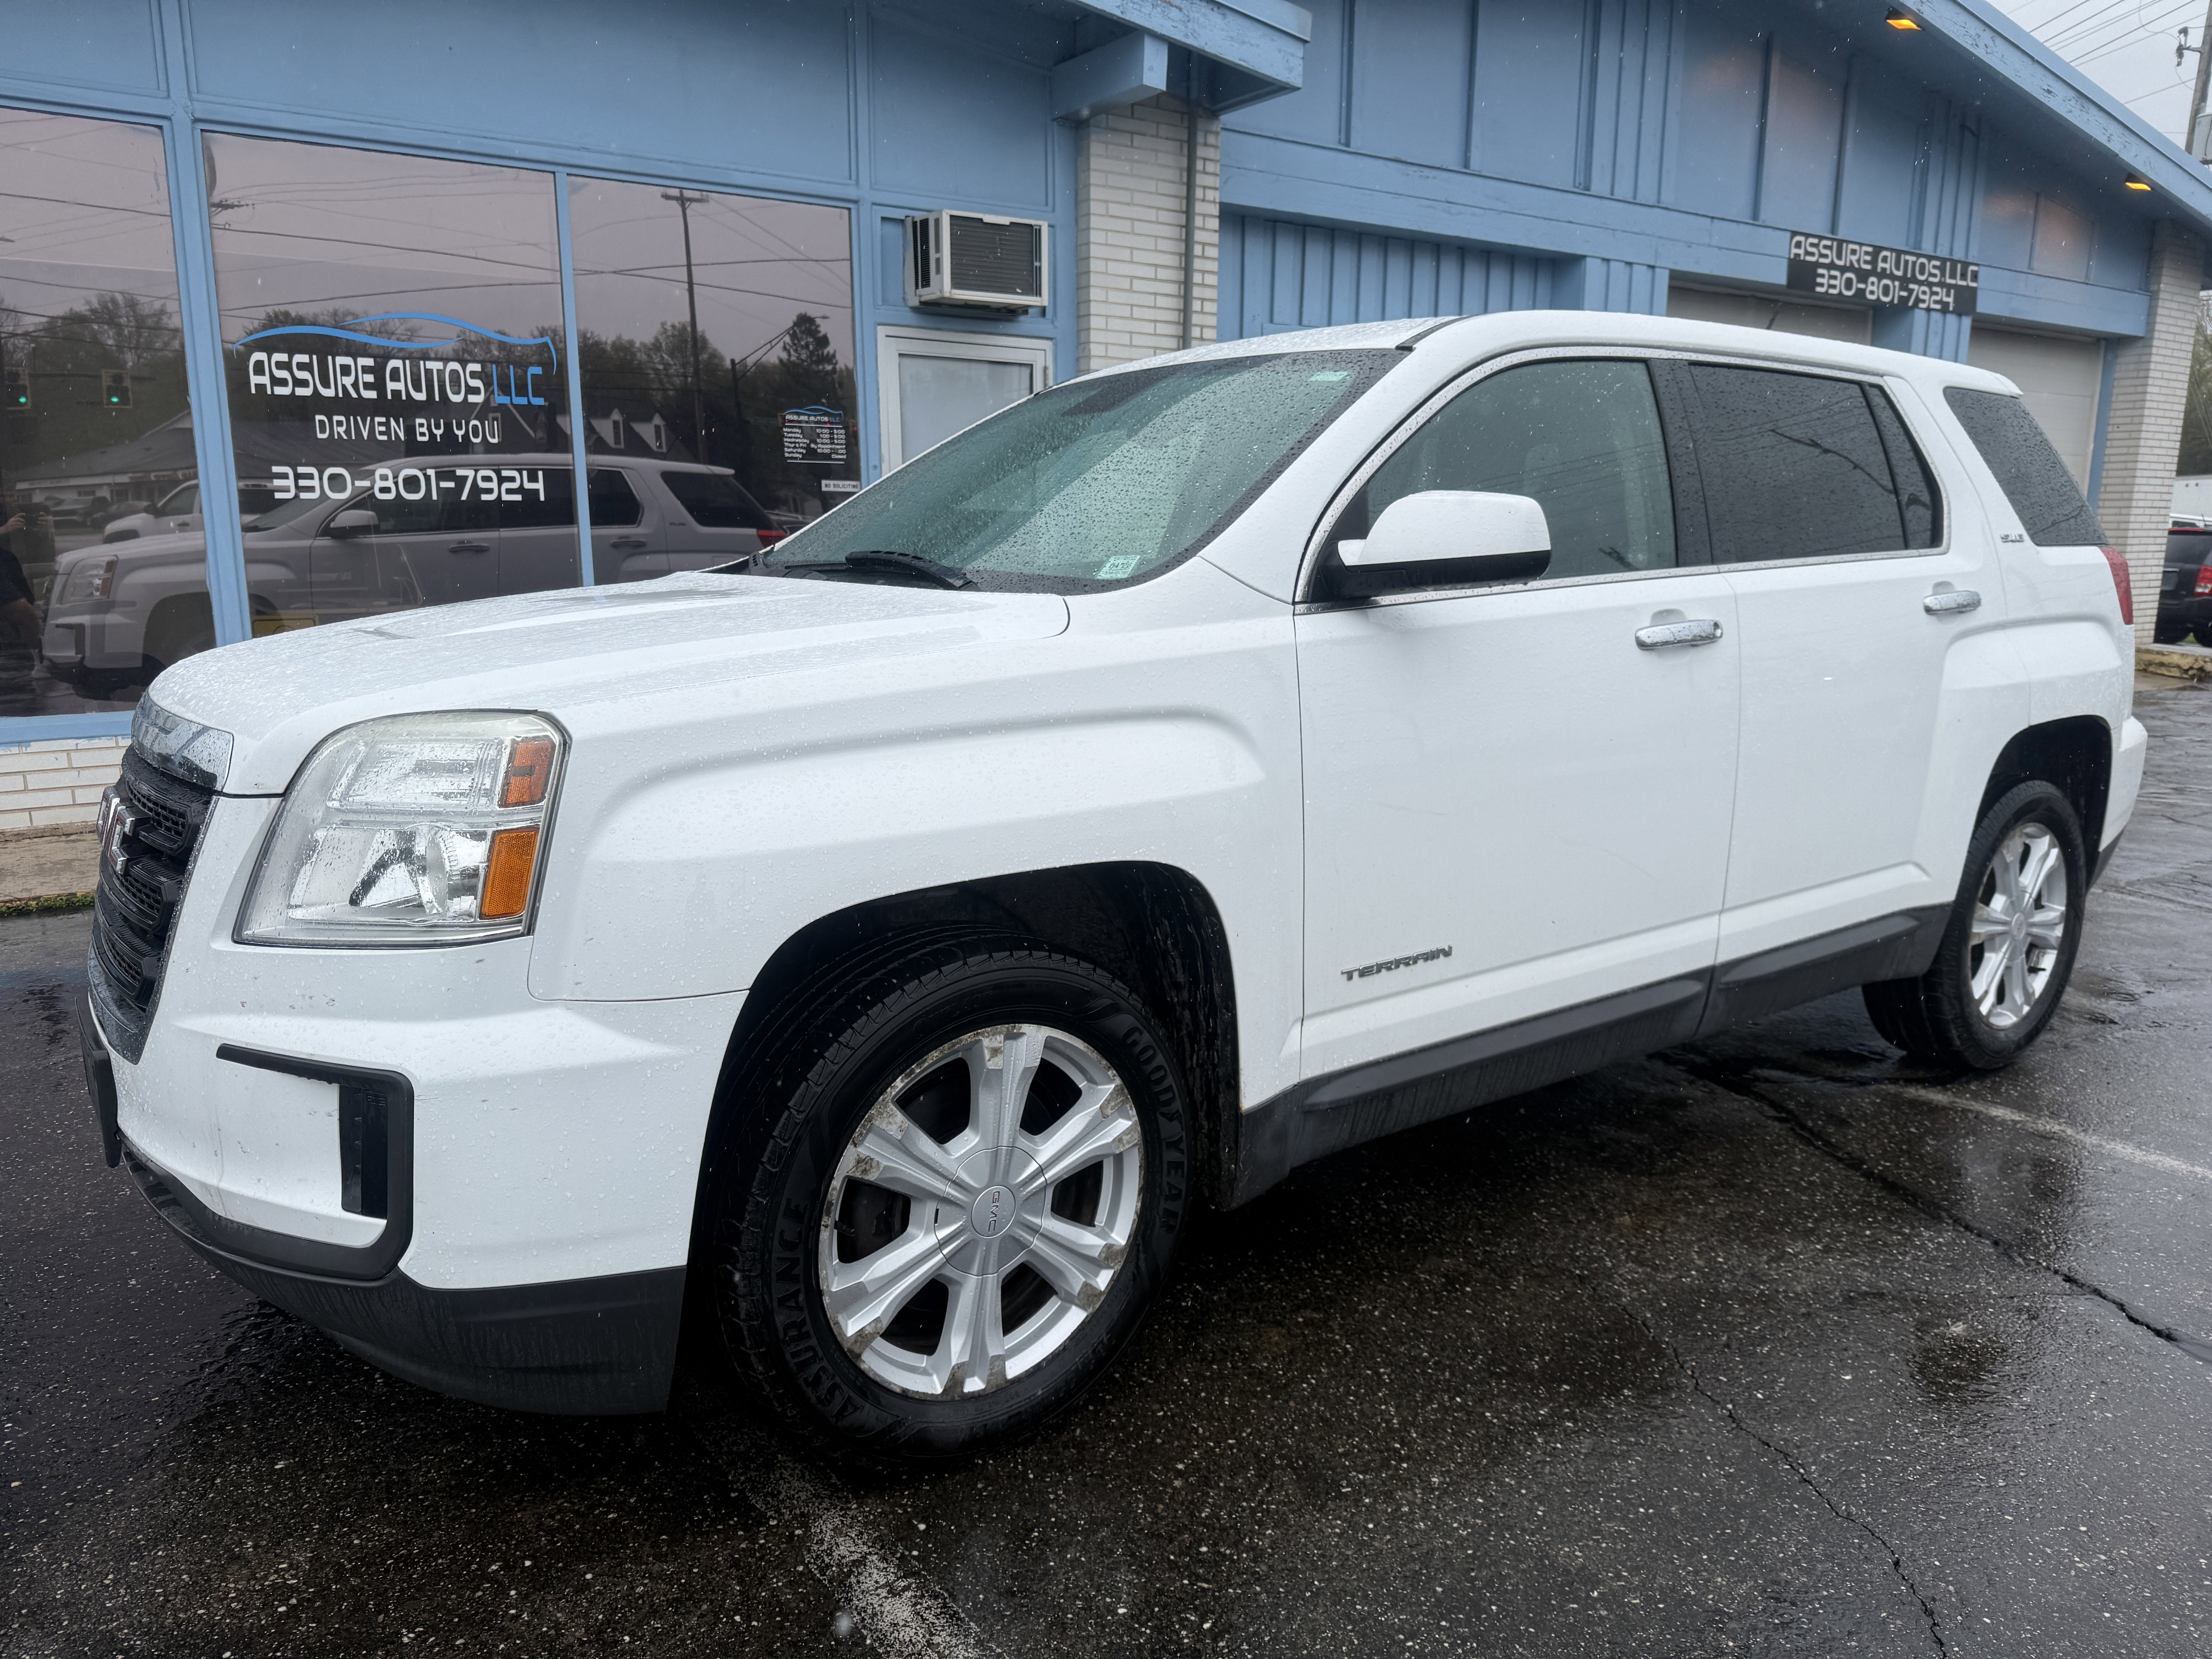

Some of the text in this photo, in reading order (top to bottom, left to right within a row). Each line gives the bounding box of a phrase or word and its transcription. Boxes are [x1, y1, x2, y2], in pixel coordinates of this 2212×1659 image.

[1790, 235, 1873, 270] ASSURE
[1815, 268, 1954, 311] 330-801-7924
[249, 352, 544, 405] ASSURE AUTOS LLC
[315, 414, 498, 443] DRIVEN BY YOU
[271, 466, 544, 501] 330-801-7924
[1341, 944, 1453, 981] TERRAIN
[1123, 1025, 1185, 1234] GOODYEAR
[988, 1191, 1000, 1232] GMC
[776, 1197, 862, 1419] ASSURANCE
